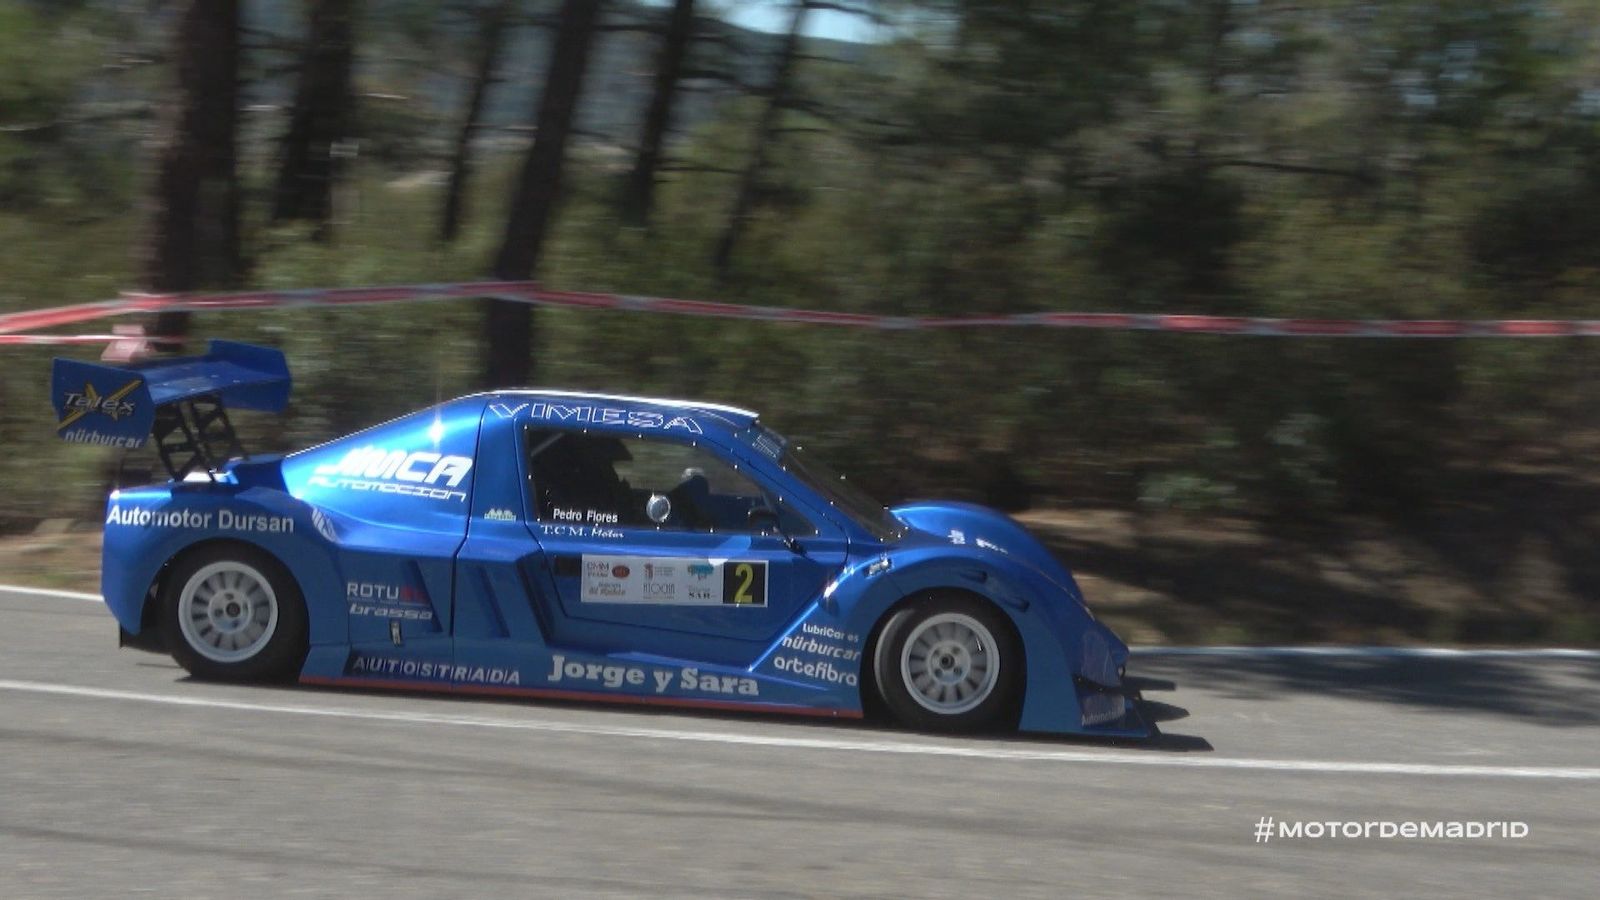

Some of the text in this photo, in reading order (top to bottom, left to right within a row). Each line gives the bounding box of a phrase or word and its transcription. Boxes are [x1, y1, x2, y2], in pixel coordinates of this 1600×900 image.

[489, 403, 702, 434] VIMESA
[65, 429, 142, 448] nürburcar
[106, 504, 212, 527] Automotor
[218, 509, 294, 533] Dursan
[553, 508, 618, 522] Pedro Flores
[734, 563, 754, 603] 2
[782, 636, 861, 660] nürburcar
[548, 655, 759, 695] Jorge y Sara
[774, 656, 858, 686] artefibra
